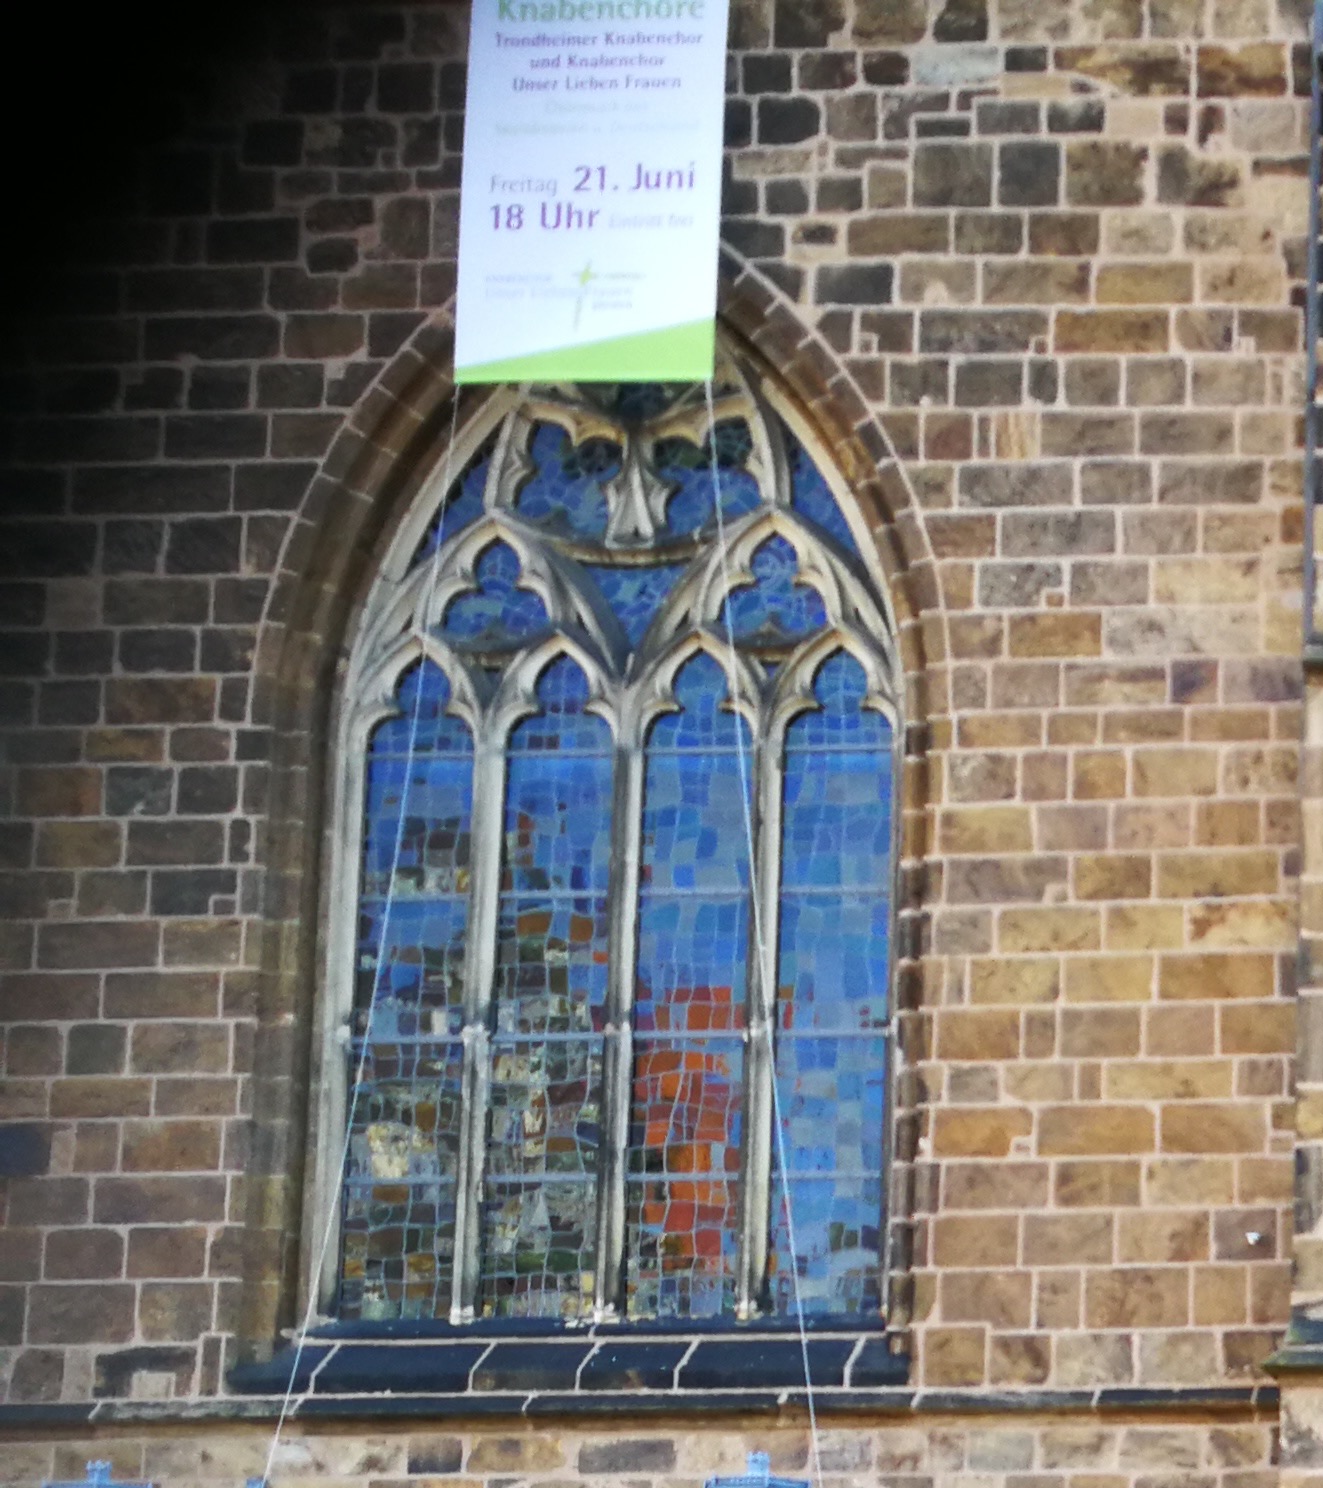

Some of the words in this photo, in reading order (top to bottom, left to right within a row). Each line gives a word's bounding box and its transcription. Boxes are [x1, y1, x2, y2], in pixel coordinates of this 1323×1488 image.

[604, 31, 704, 46] Knabenchor
[528, 54, 561, 69] und
[566, 53, 666, 67] Knabenchor
[512, 77, 558, 92] Unser
[565, 76, 619, 91] Lieben
[625, 74, 682, 89] Frauen
[489, 174, 558, 197] Freitag
[573, 164, 620, 192] 21.
[628, 161, 696, 191] Juni
[489, 203, 525, 231] 18
[539, 201, 600, 230] Uhr
